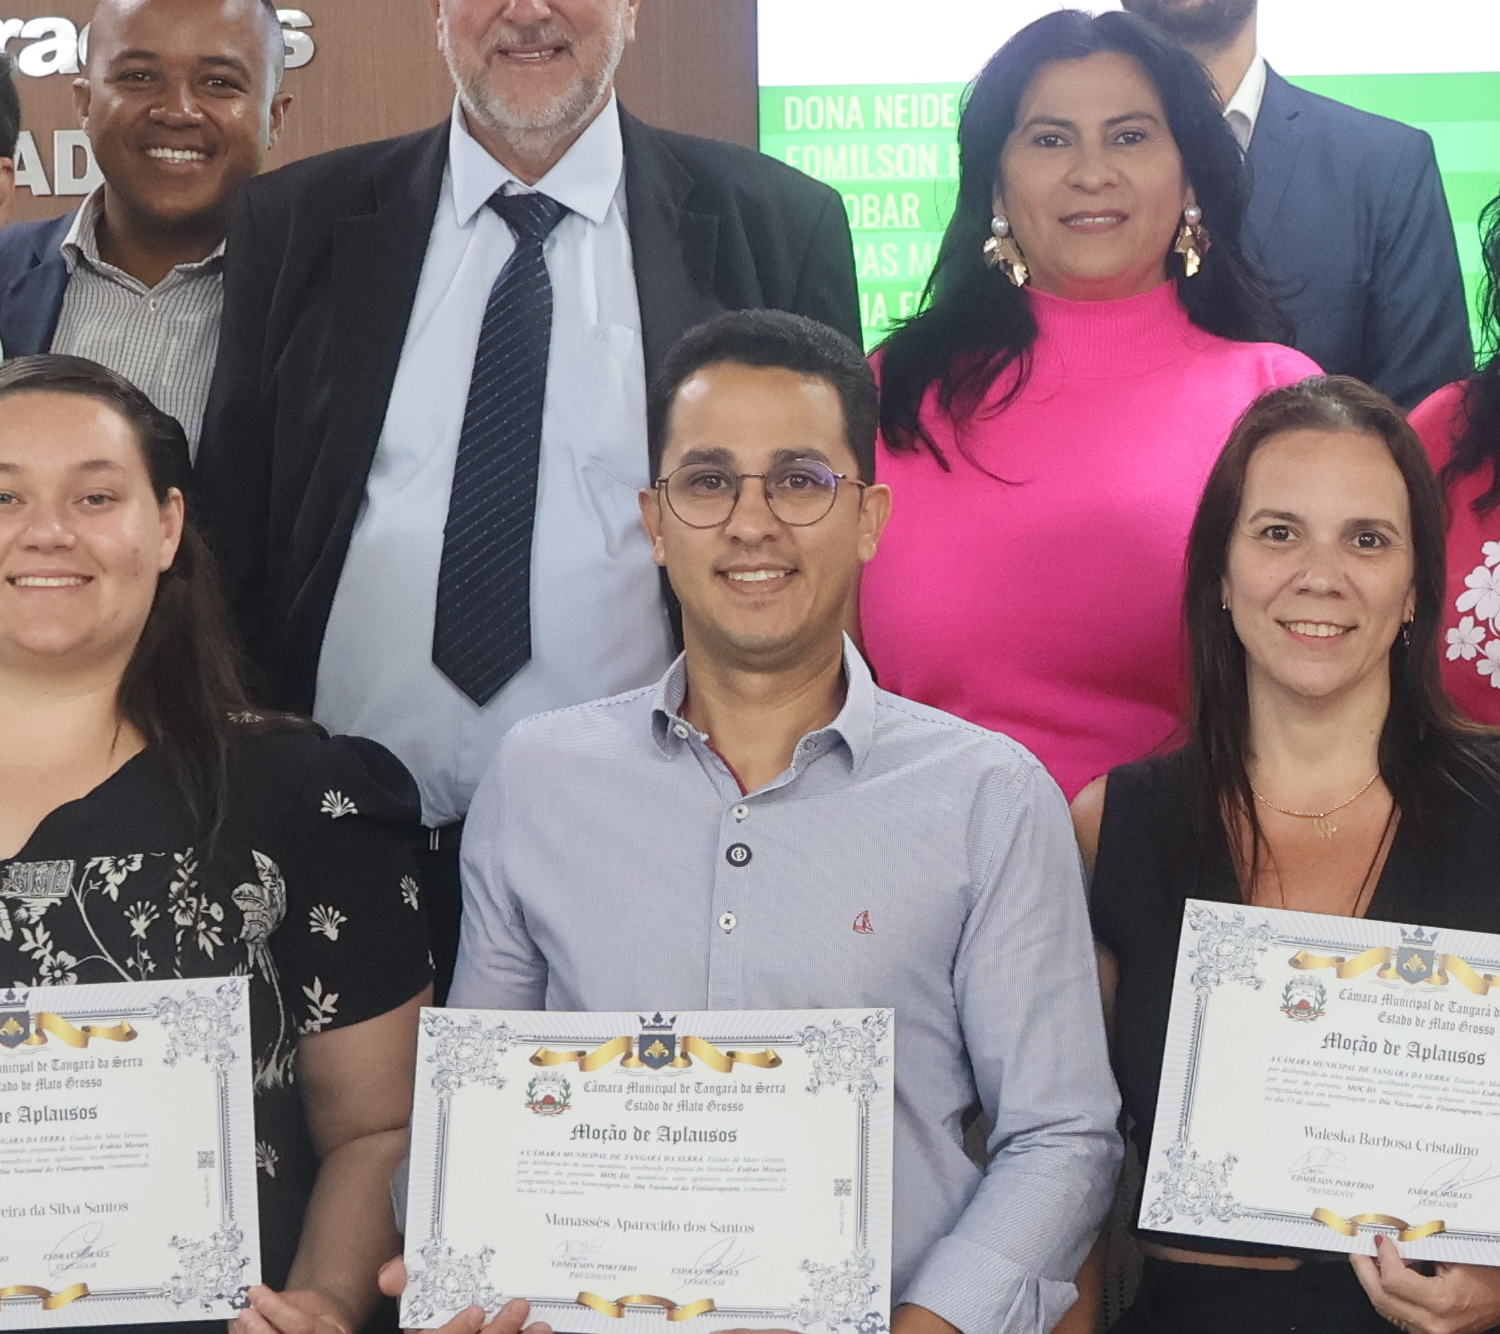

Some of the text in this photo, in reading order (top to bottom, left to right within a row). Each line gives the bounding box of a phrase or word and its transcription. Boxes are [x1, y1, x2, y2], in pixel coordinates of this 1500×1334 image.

[784, 93, 956, 131] DONA NEIDE
[785, 143, 937, 180] EDMILSON
[1321, 1032, 1486, 1065] Moção de Aplausos
[17, 1106, 97, 1125] Aplausos
[570, 1124, 737, 1144] Moção de Aplausos
[1305, 1126, 1478, 1156] Waleska Barbosa Cristalino
[30, 1204, 45, 1216] da
[50, 1203, 80, 1215] Silva
[85, 1202, 128, 1213] Santos
[614, 1218, 680, 1232] Aparecido
[683, 1221, 706, 1232] dos
[710, 1222, 754, 1233] Santos
